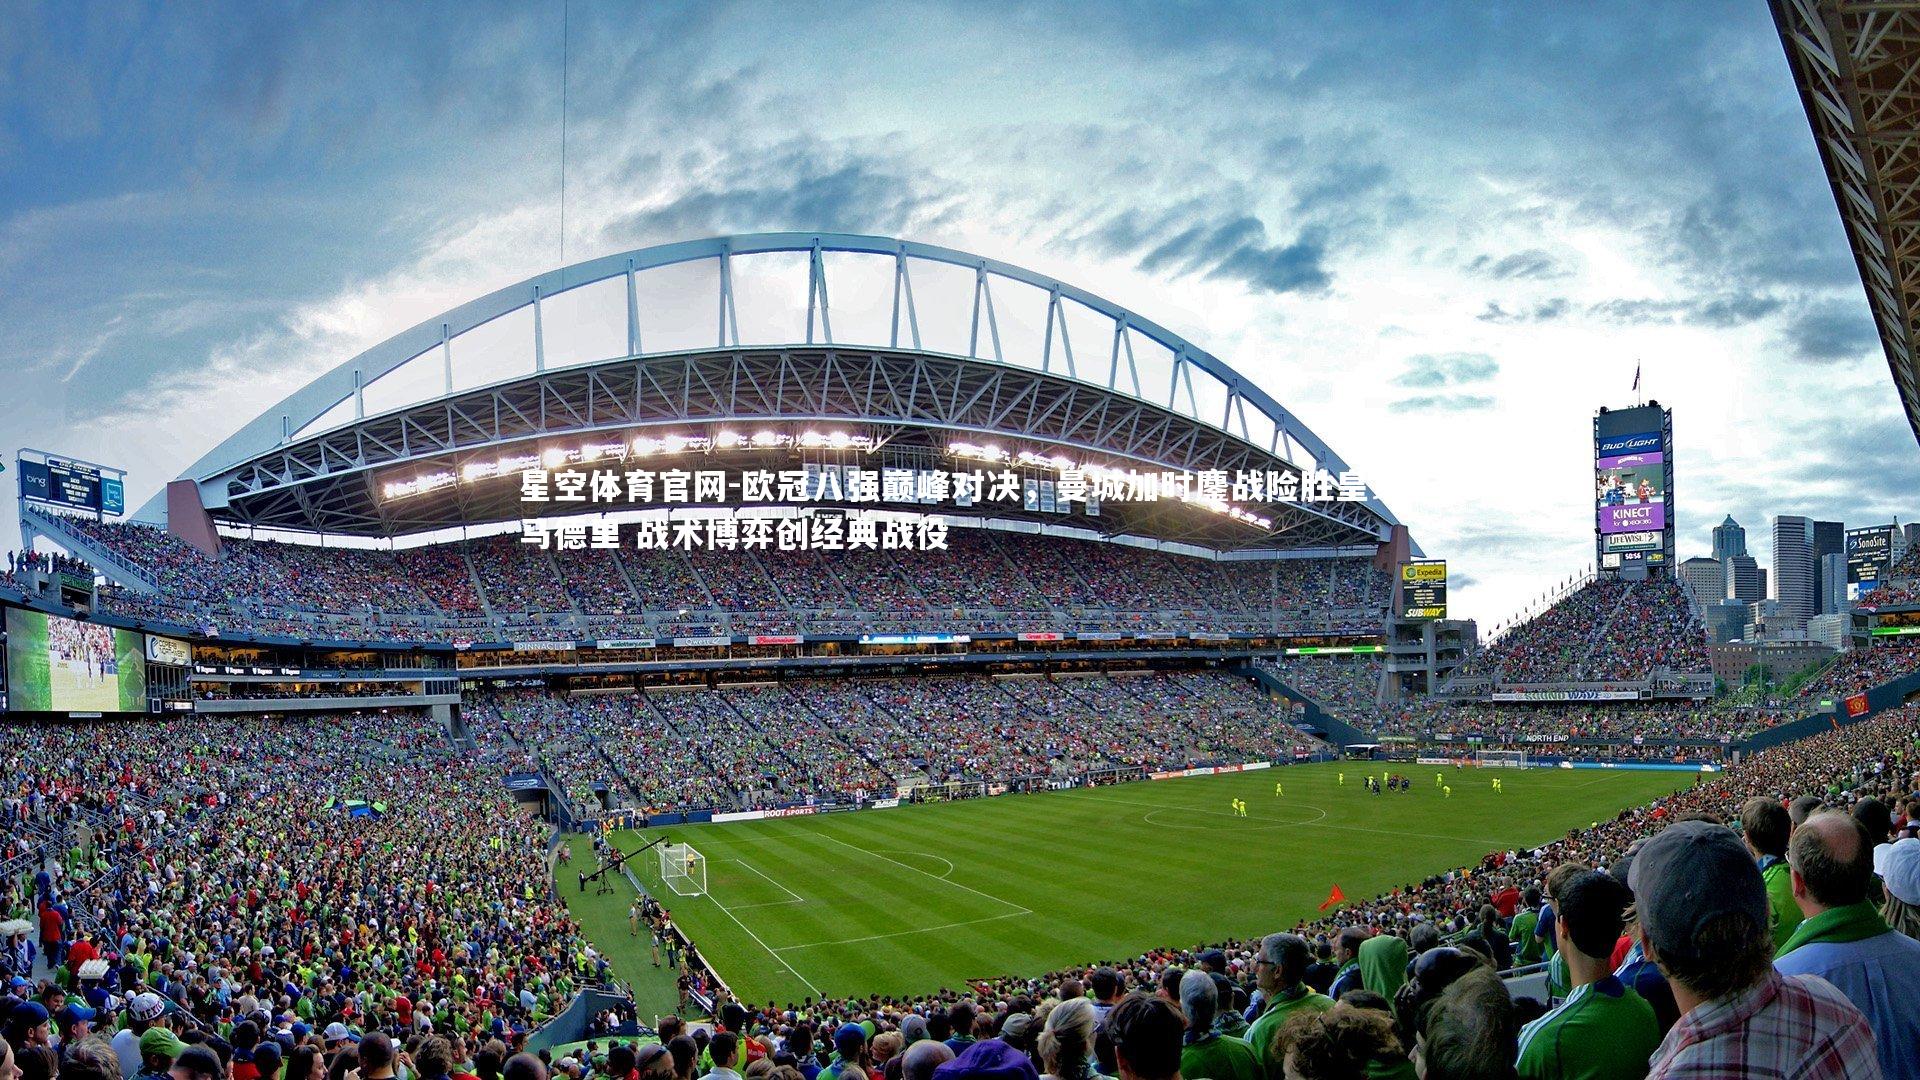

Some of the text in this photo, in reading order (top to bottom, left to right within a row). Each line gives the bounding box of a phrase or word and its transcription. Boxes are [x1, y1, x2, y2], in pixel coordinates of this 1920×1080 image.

[1629, 438, 1658, 447] LIGHT
[26, 475, 46, 488] bing
[1613, 507, 1652, 520] KINECT
[1858, 537, 1886, 548] SonoSite
[1417, 569, 1443, 578] Expedia
[1405, 607, 1445, 618] SUBWAY
[1526, 734, 1569, 743] NORTH END
[765, 807, 813, 818] ROOT SPORTS
